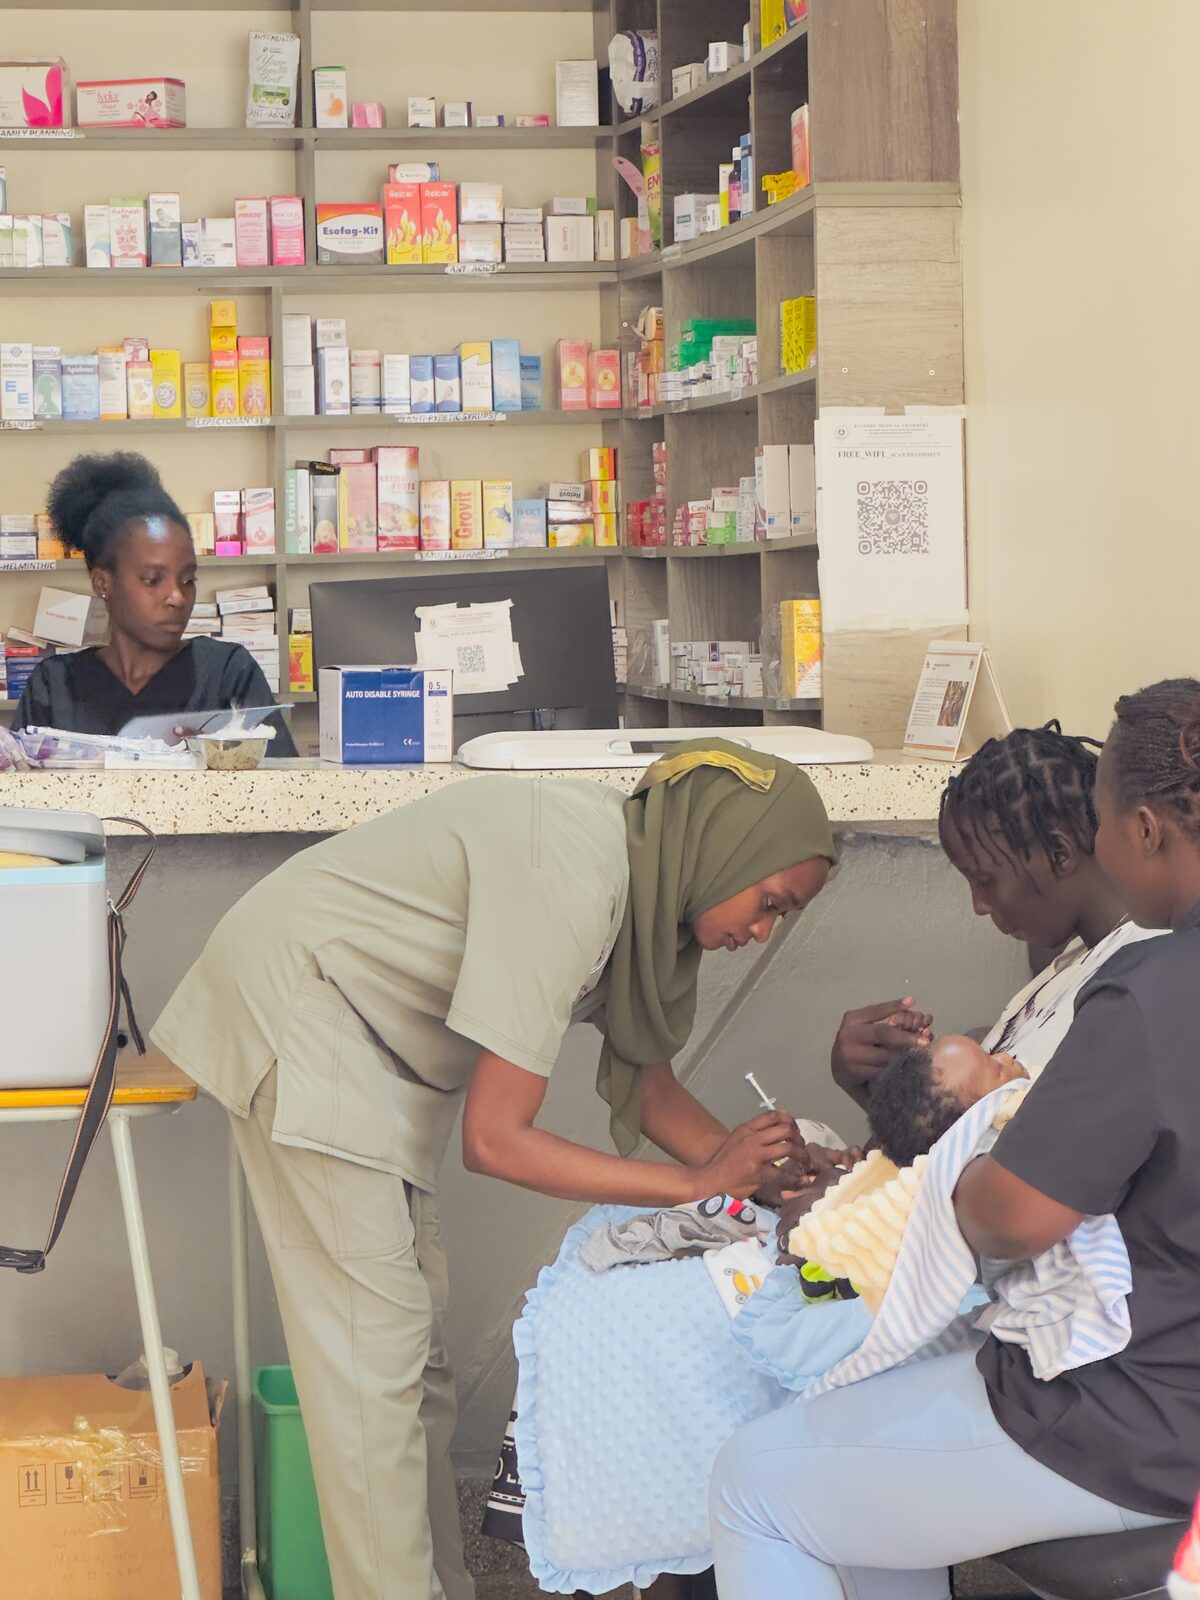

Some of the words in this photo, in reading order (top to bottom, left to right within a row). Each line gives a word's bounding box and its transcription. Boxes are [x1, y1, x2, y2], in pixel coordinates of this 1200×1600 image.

[29, 129, 73, 138] PLANNING
[322, 226, 379, 239] Esofag-Kit
[462, 412, 494, 421] SYRUPS
[454, 491, 472, 539] Grovit
[345, 690, 364, 698] AUTO
[364, 690, 391, 698] DISABLE
[392, 690, 420, 698] SYRINGE
